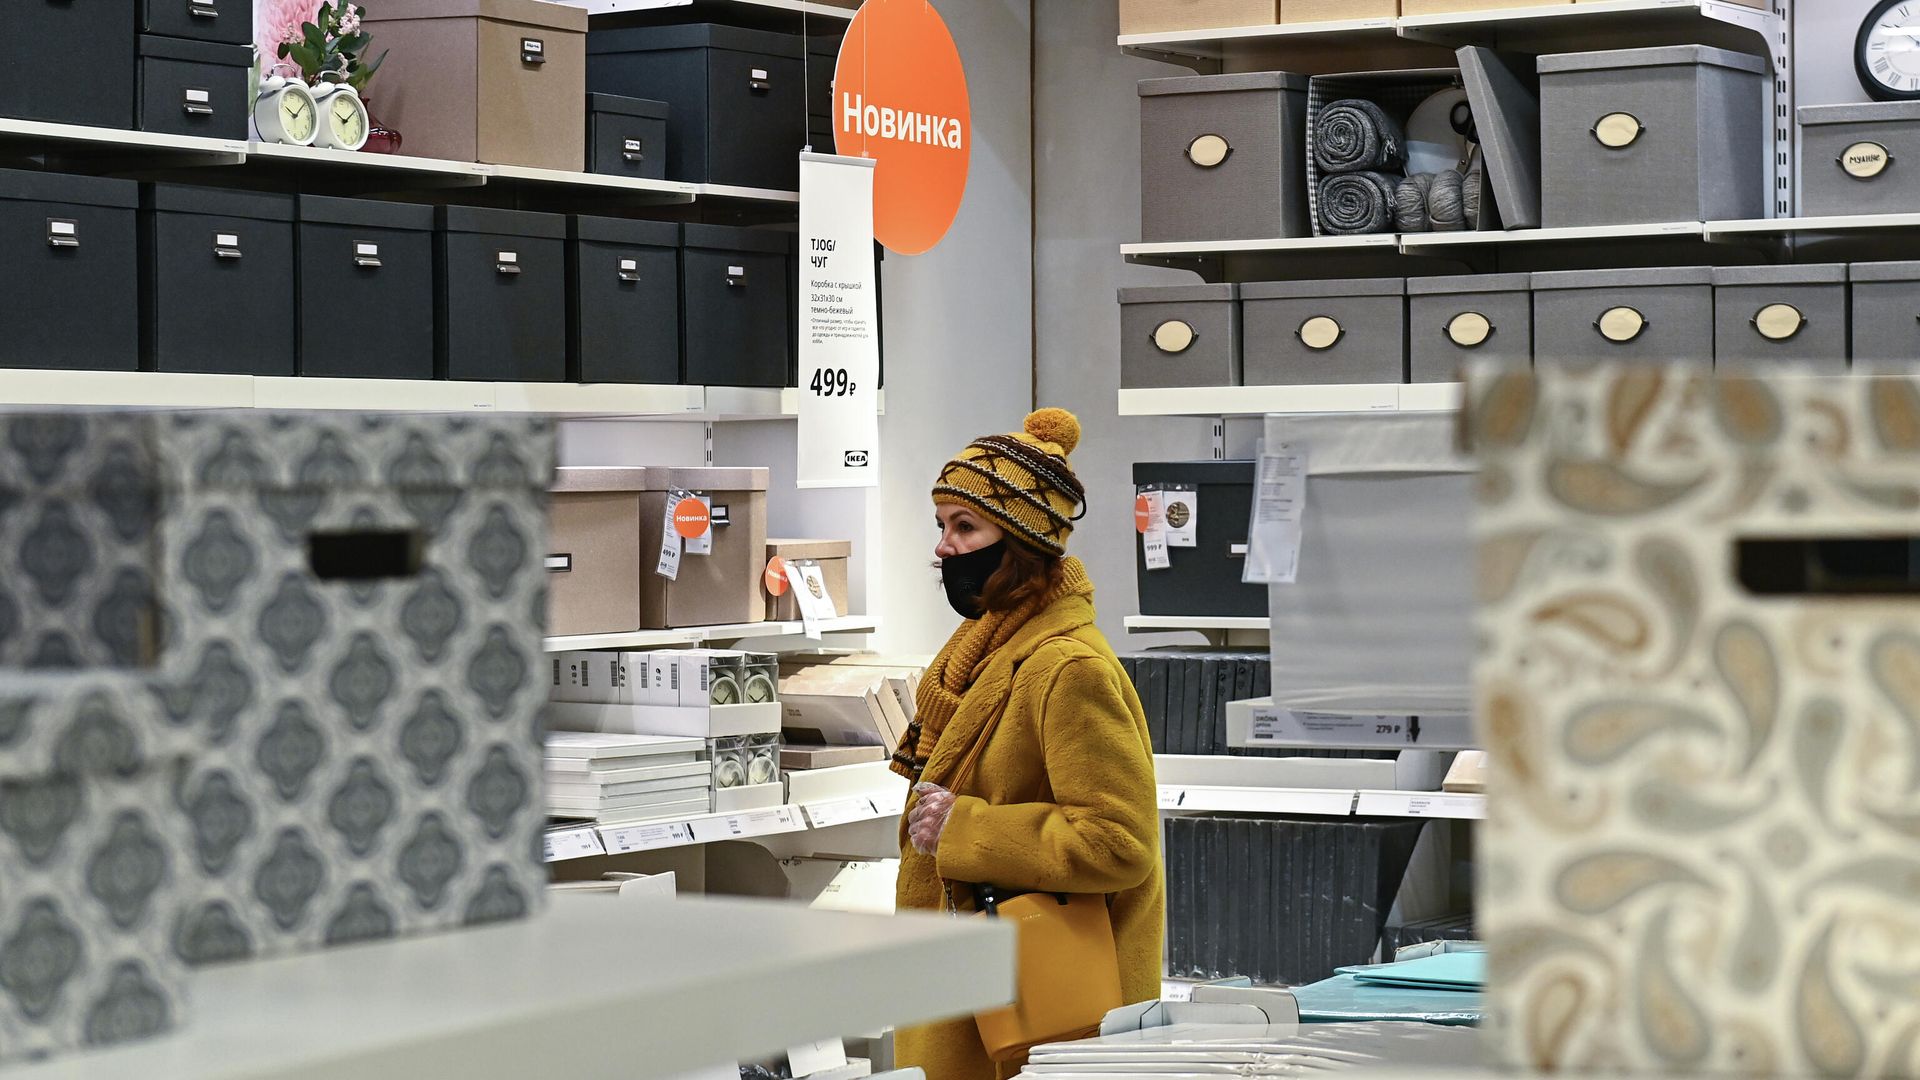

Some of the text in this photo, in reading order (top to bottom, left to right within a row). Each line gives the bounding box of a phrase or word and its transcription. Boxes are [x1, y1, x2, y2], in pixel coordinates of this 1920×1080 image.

[843, 91, 962, 150] Новинка
[811, 238, 836, 251] TJOG/
[811, 255, 828, 268] ЧУГ
[811, 279, 833, 290] Коробка
[839, 281, 862, 290] крышкой
[1376, 725, 1392, 734] 279
